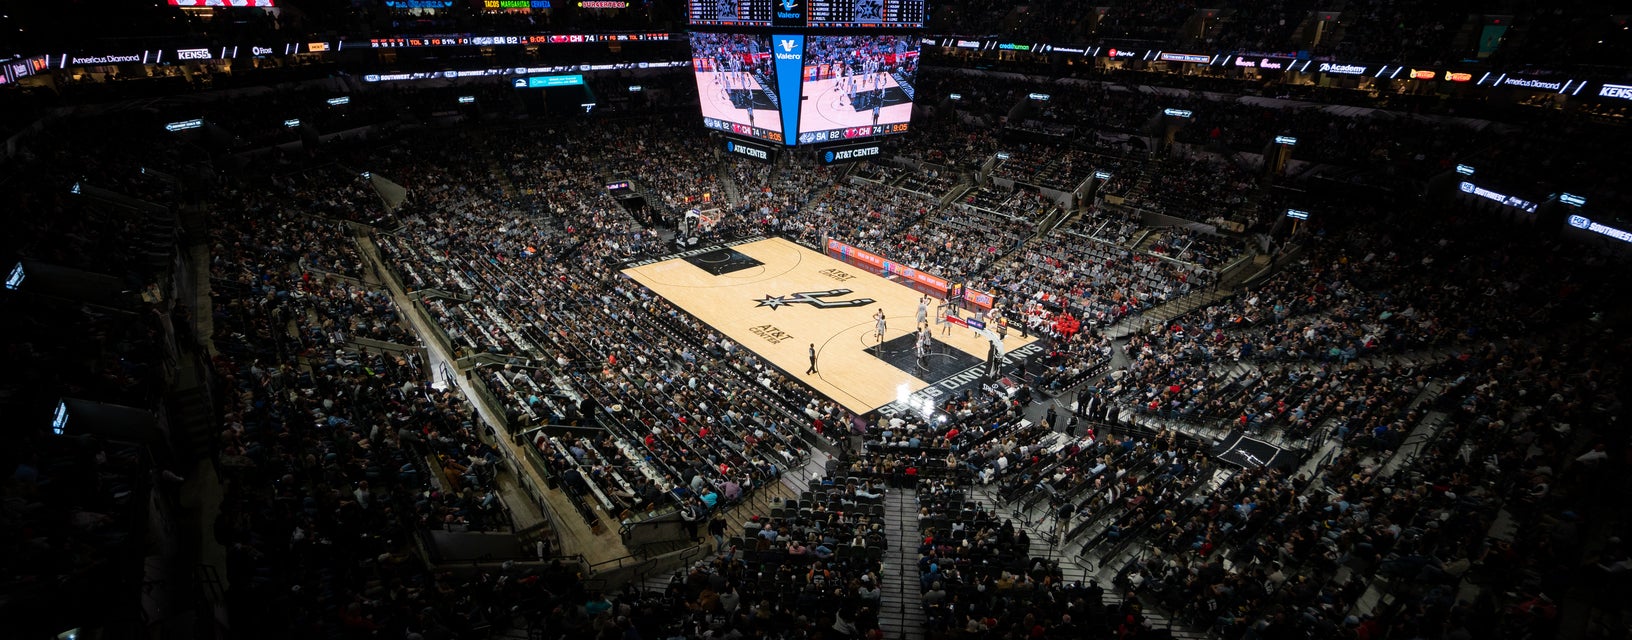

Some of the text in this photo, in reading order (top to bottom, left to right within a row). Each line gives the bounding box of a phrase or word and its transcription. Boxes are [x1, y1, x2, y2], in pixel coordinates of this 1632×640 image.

[73, 54, 139, 64] Americus Diamond
[1330, 64, 1366, 73] Academy
[1505, 78, 1560, 90] Americus Diamond
[734, 144, 767, 159] AT&T CENTER
[835, 147, 879, 159] AT&T CENTER
[1474, 187, 1506, 202] SOUTHWEST
[661, 245, 721, 261] ANTONIO
[828, 268, 856, 280] AT&T
[749, 327, 781, 344] CENTER
[757, 325, 794, 340] AT&T
[1011, 343, 1043, 361] SAN
